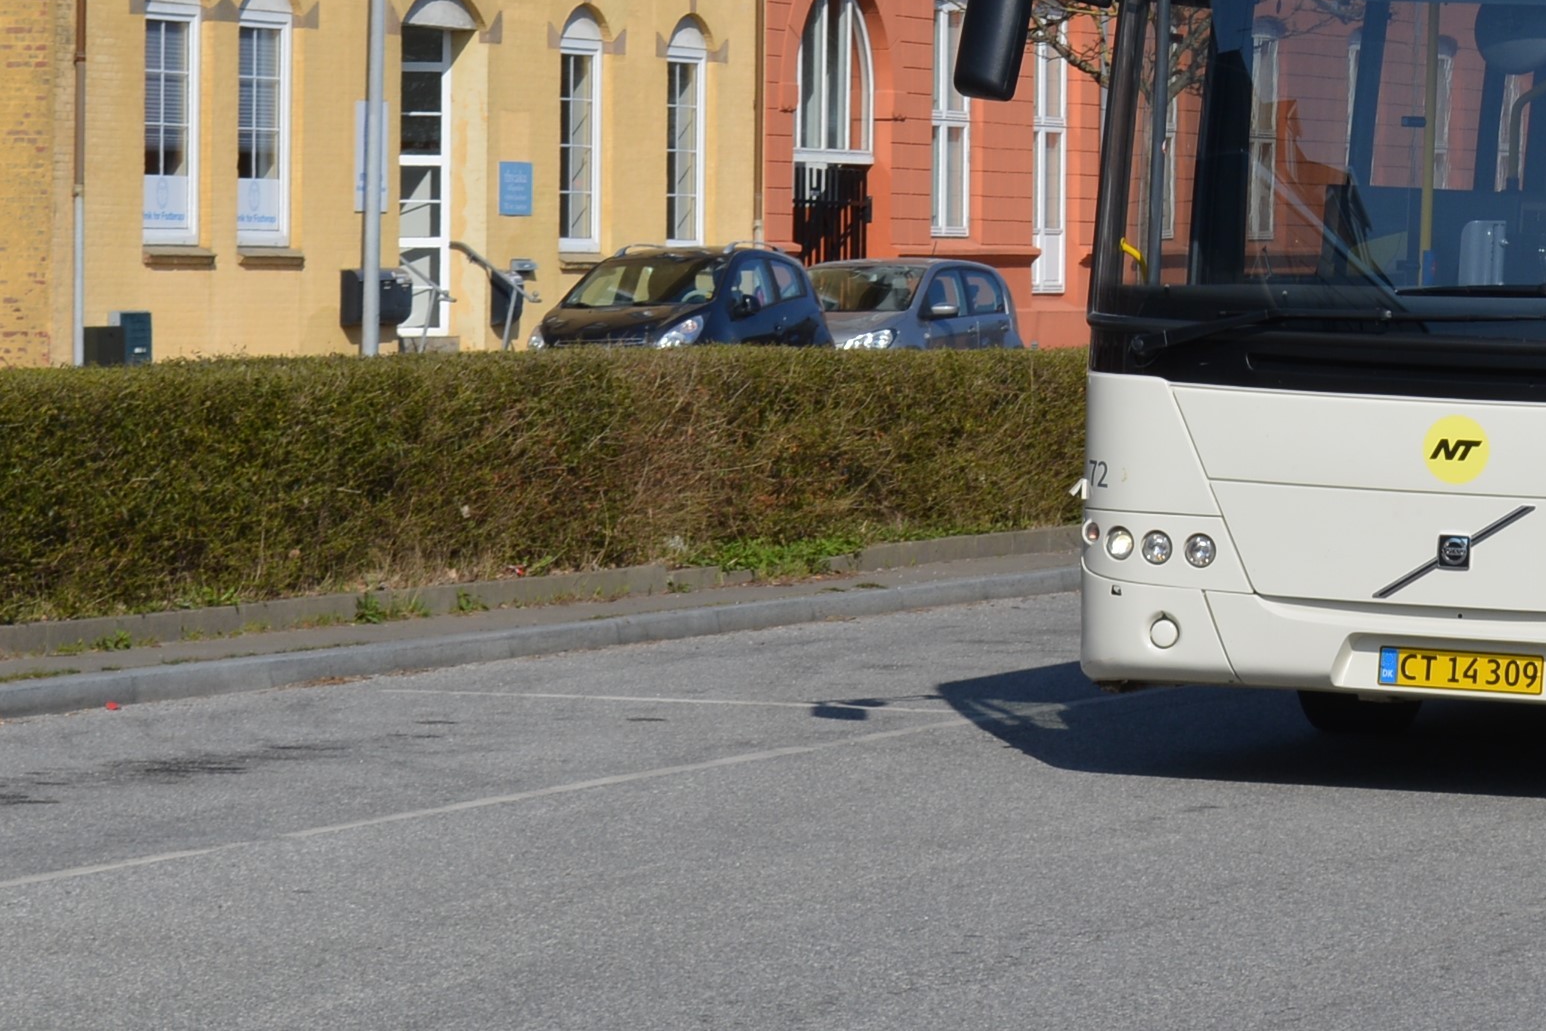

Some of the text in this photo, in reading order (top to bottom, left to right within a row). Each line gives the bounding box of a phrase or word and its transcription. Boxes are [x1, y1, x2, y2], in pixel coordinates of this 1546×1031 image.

[1429, 438, 1483, 462] NT
[1089, 459, 1108, 489] 72
[1381, 668, 1394, 678] DK
[1400, 653, 1539, 689] CT 14 309
